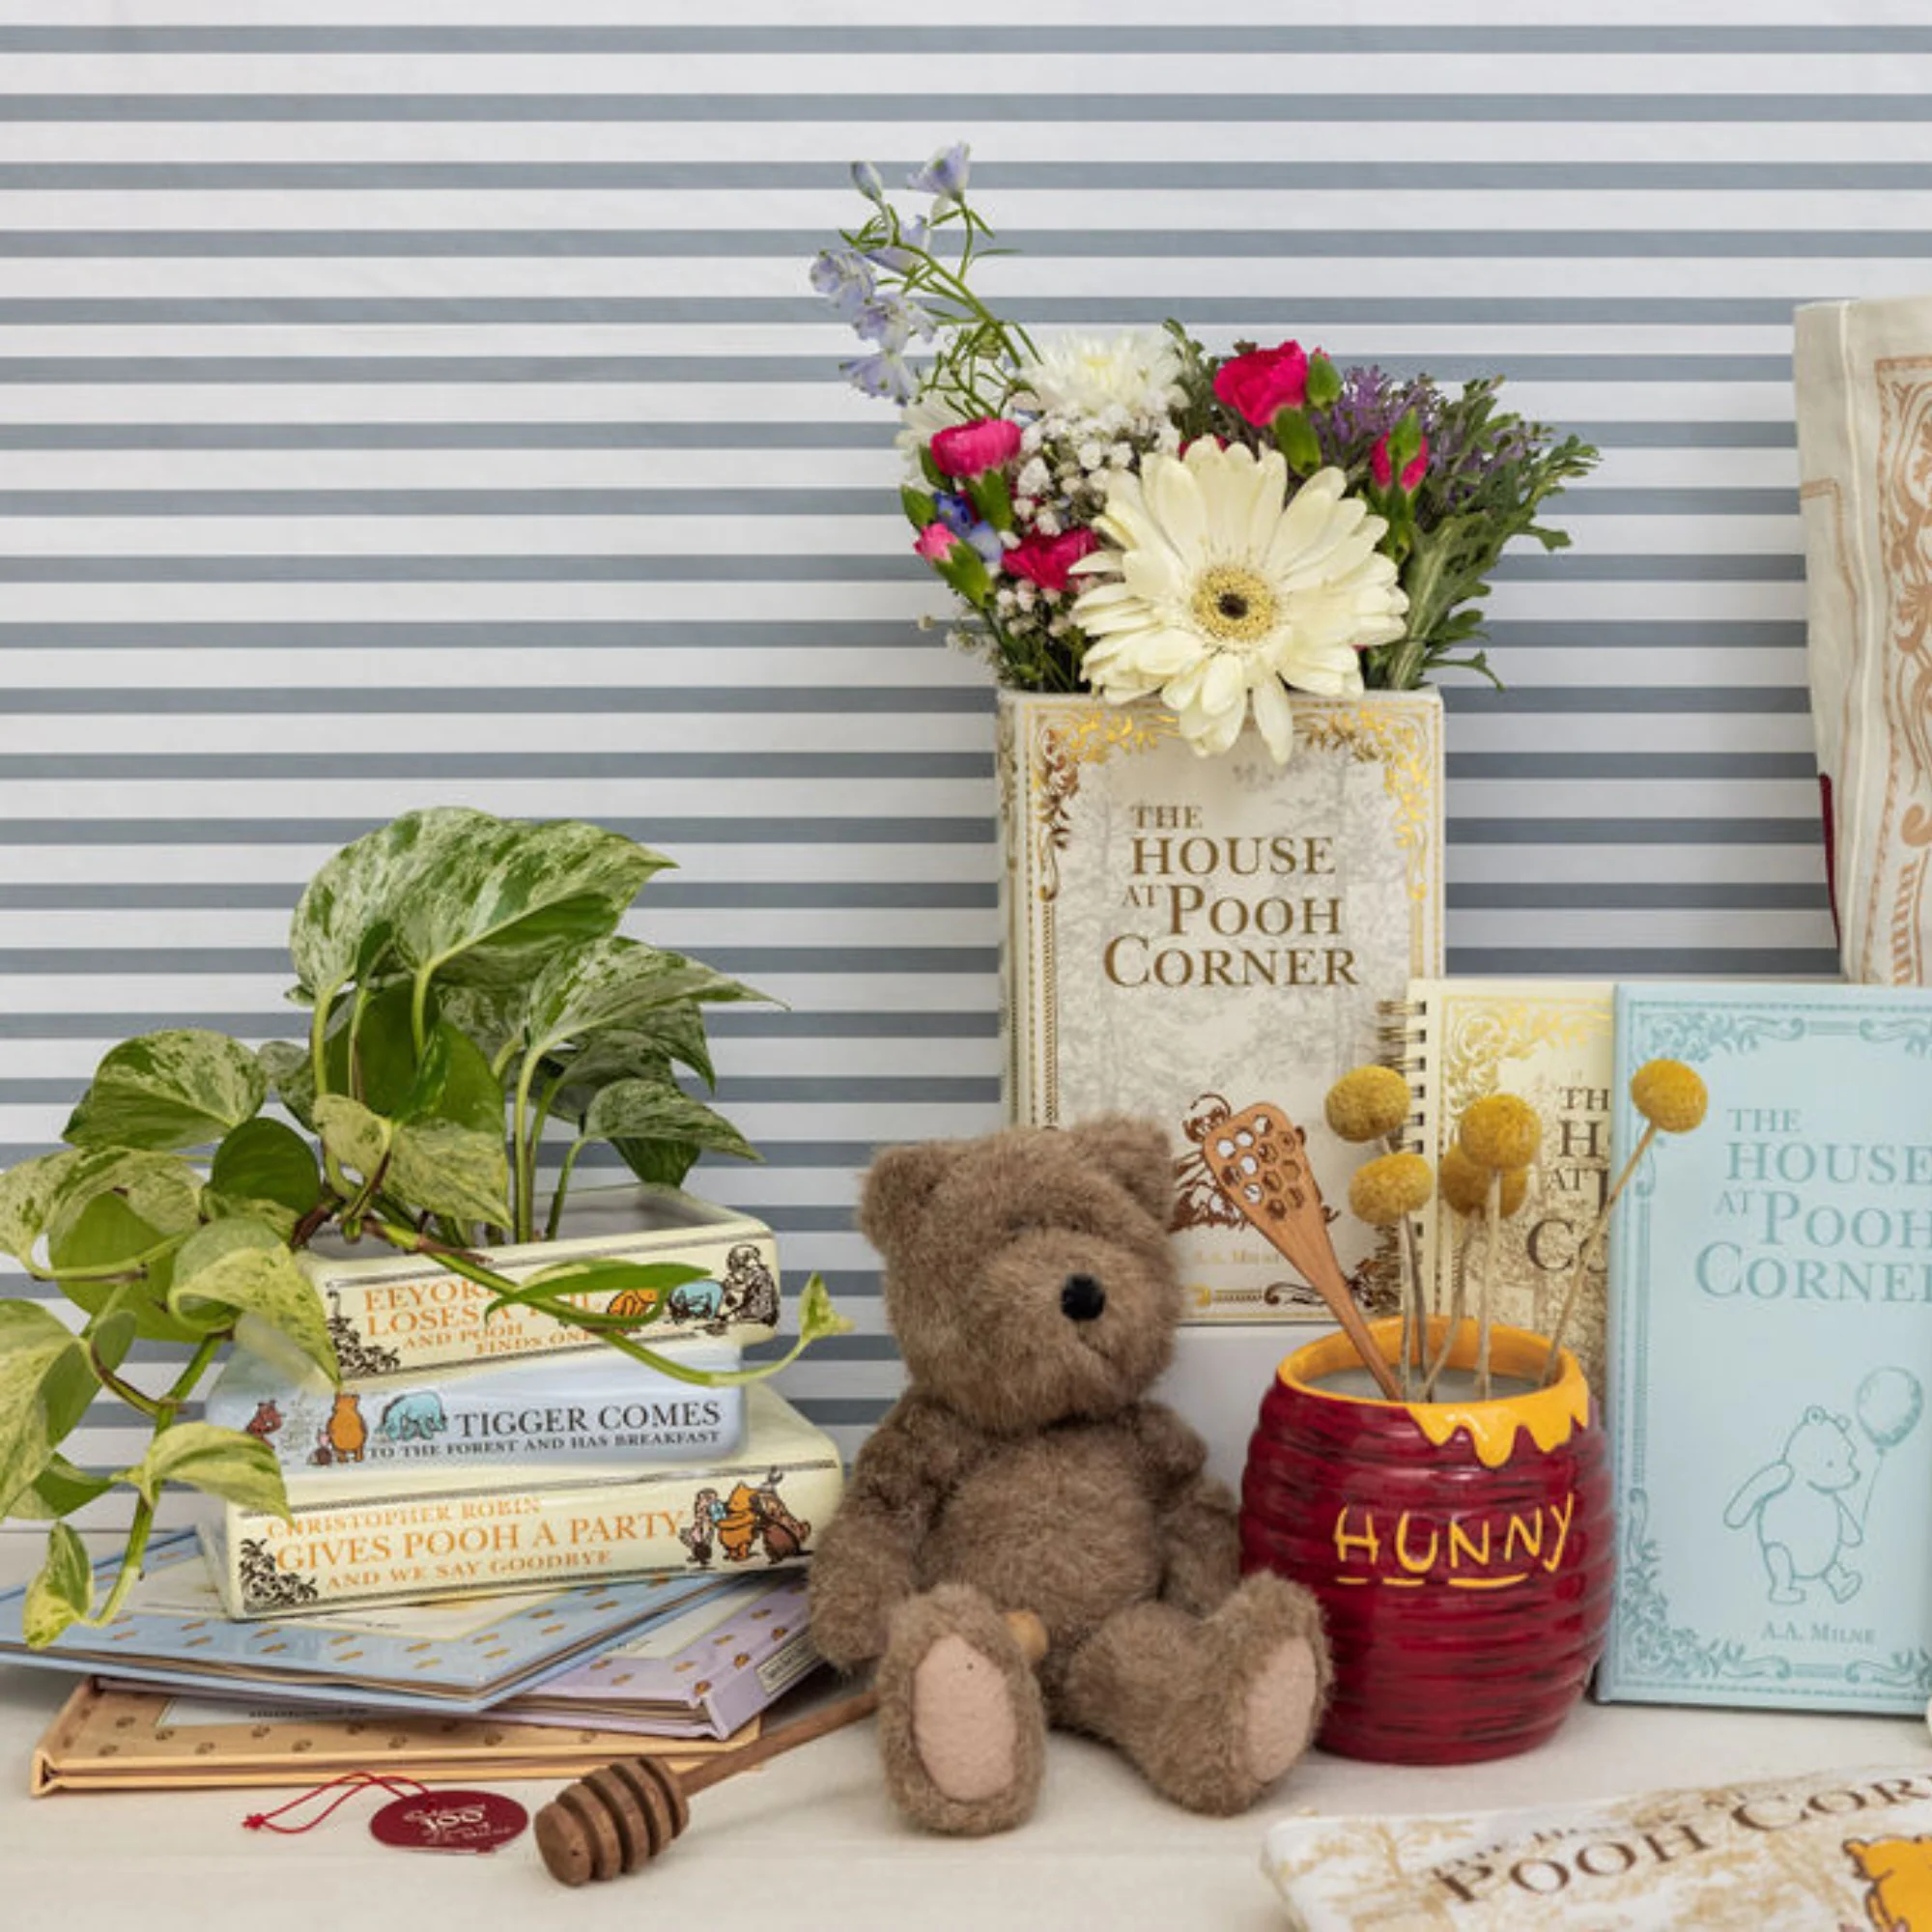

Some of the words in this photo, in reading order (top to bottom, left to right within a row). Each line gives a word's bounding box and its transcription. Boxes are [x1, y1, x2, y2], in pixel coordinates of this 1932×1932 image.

[1130, 806, 1203, 829] THE
[1130, 837, 1336, 875] HOUSE
[1122, 885, 1159, 908] AT
[1166, 884, 1343, 936] POOH
[1103, 933, 1359, 987] CORNER
[1559, 1089, 1610, 1110] TH
[1726, 1109, 1802, 1132] THE
[1725, 1141, 1932, 1185] HOUSE
[1715, 1189, 1754, 1214] AT
[1759, 1189, 1932, 1249] POOH
[364, 1279, 496, 1312] EEYOR
[366, 1305, 479, 1336] LOSES
[403, 1331, 452, 1350] AND
[454, 1407, 587, 1438] TIGGER
[599, 1401, 722, 1432] COMES
[403, 1443, 444, 1458] THE
[447, 1439, 515, 1456] FOREST
[524, 1436, 565, 1451] AND
[571, 1435, 609, 1449] HAS
[614, 1430, 721, 1447] BREAKFAST
[461, 1496, 541, 1520] ROBIN
[276, 1535, 392, 1571] GIVES
[403, 1522, 520, 1559] POOH
[532, 1520, 558, 1548] A
[568, 1509, 685, 1546] PARTY
[1334, 1492, 1574, 1573] HUNNY
[327, 1571, 381, 1591] AND
[390, 1565, 425, 1582] WE
[436, 1560, 480, 1578] SAY
[490, 1549, 611, 1575] GOODBYE
[1433, 1823, 1713, 1902] POOH
[1731, 1776, 1932, 1832] COR
